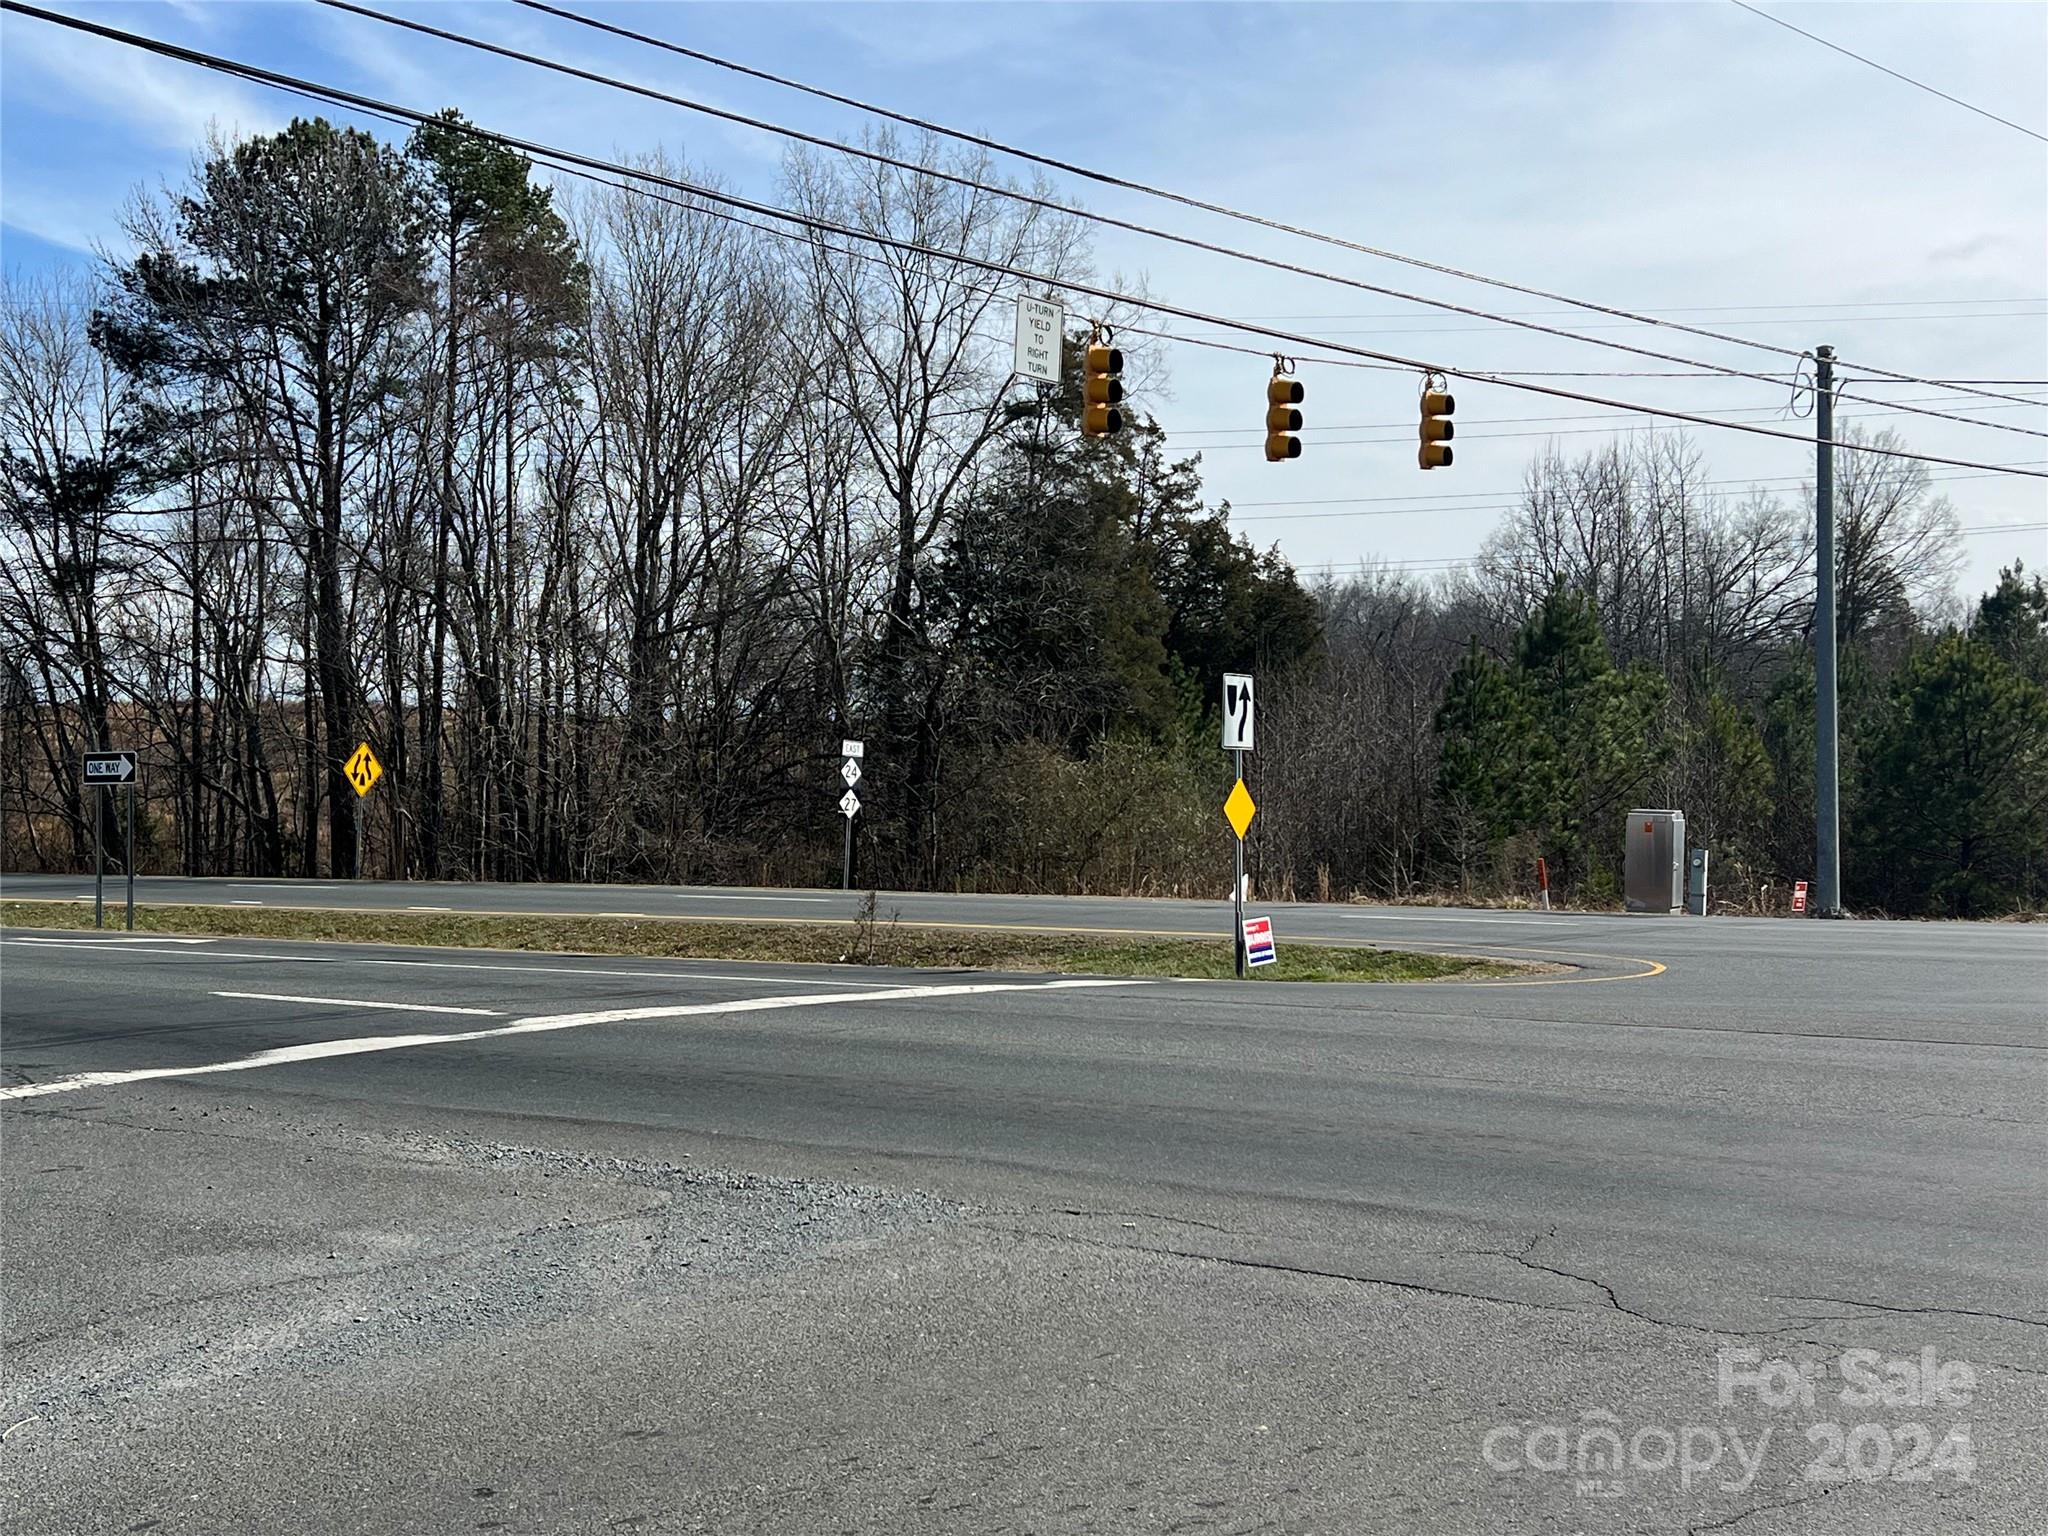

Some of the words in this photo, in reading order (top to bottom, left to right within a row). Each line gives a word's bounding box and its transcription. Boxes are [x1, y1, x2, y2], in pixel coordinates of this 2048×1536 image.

[1026, 302, 1055, 318] U-TURN
[1029, 317, 1051, 332] YIELD
[1034, 333, 1044, 345] TO
[1027, 346, 1049, 361] RIGHT
[1028, 361, 1048, 375] TURN
[845, 743, 860, 754] EAST
[88, 762, 104, 774] ONE
[104, 761, 121, 774] WAY
[845, 764, 857, 779] 24
[844, 797, 857, 812] 27
